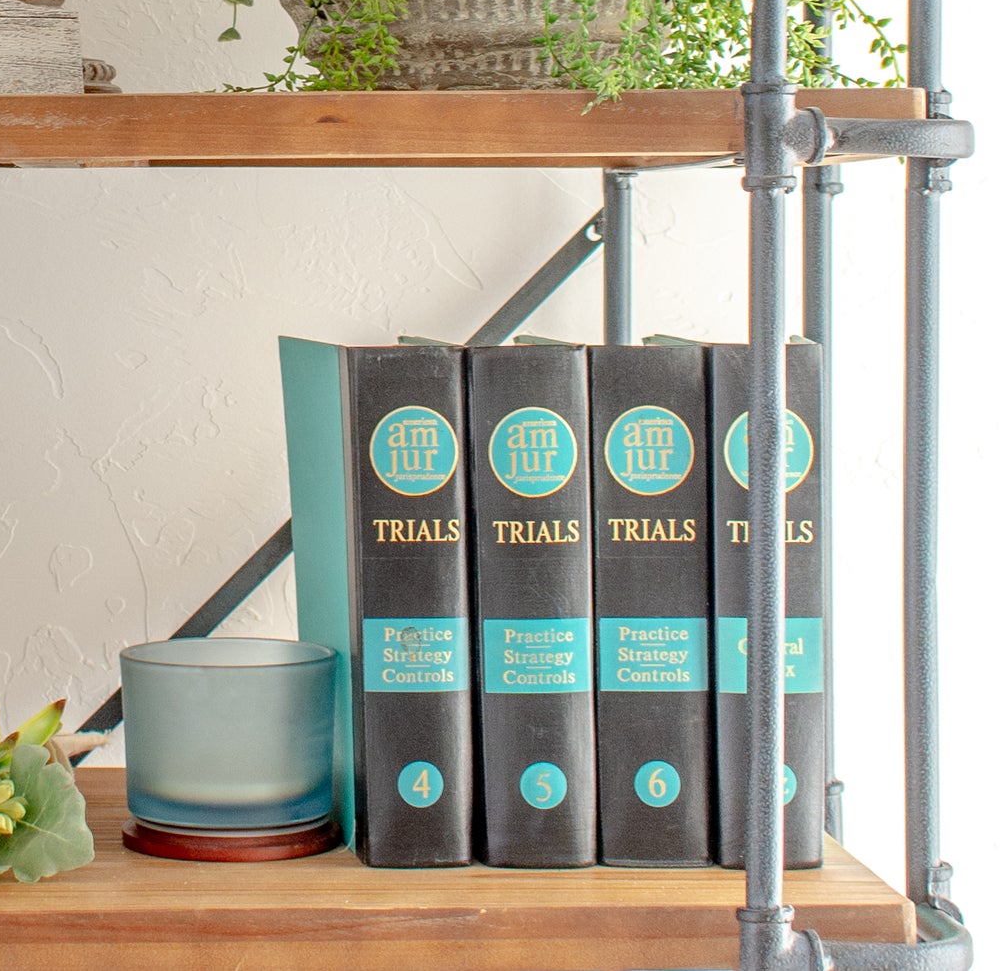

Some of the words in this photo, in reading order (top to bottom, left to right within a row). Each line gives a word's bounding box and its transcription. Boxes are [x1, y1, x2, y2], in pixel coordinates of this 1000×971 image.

[387, 423, 440, 447] am
[507, 423, 559, 449] am
[623, 422, 675, 447] am
[386, 449, 438, 478] jur
[505, 450, 558, 479] jur
[620, 448, 674, 477] jur
[372, 519, 460, 543] TRIALS
[492, 520, 581, 544] TRIALS
[608, 518, 697, 543] TRIALS
[726, 520, 815, 544] TLS
[504, 628, 574, 644] Practice
[618, 626, 689, 641] Practice
[383, 647, 453, 664] Strategy
[503, 649, 574, 666] Strategy
[618, 647, 689, 664] Strategy
[382, 668, 454, 683] Controls
[503, 670, 576, 685] Controls
[617, 668, 690, 683] Controls
[412, 769, 431, 799] 4
[535, 772, 553, 802] 5
[648, 768, 667, 798] 6
